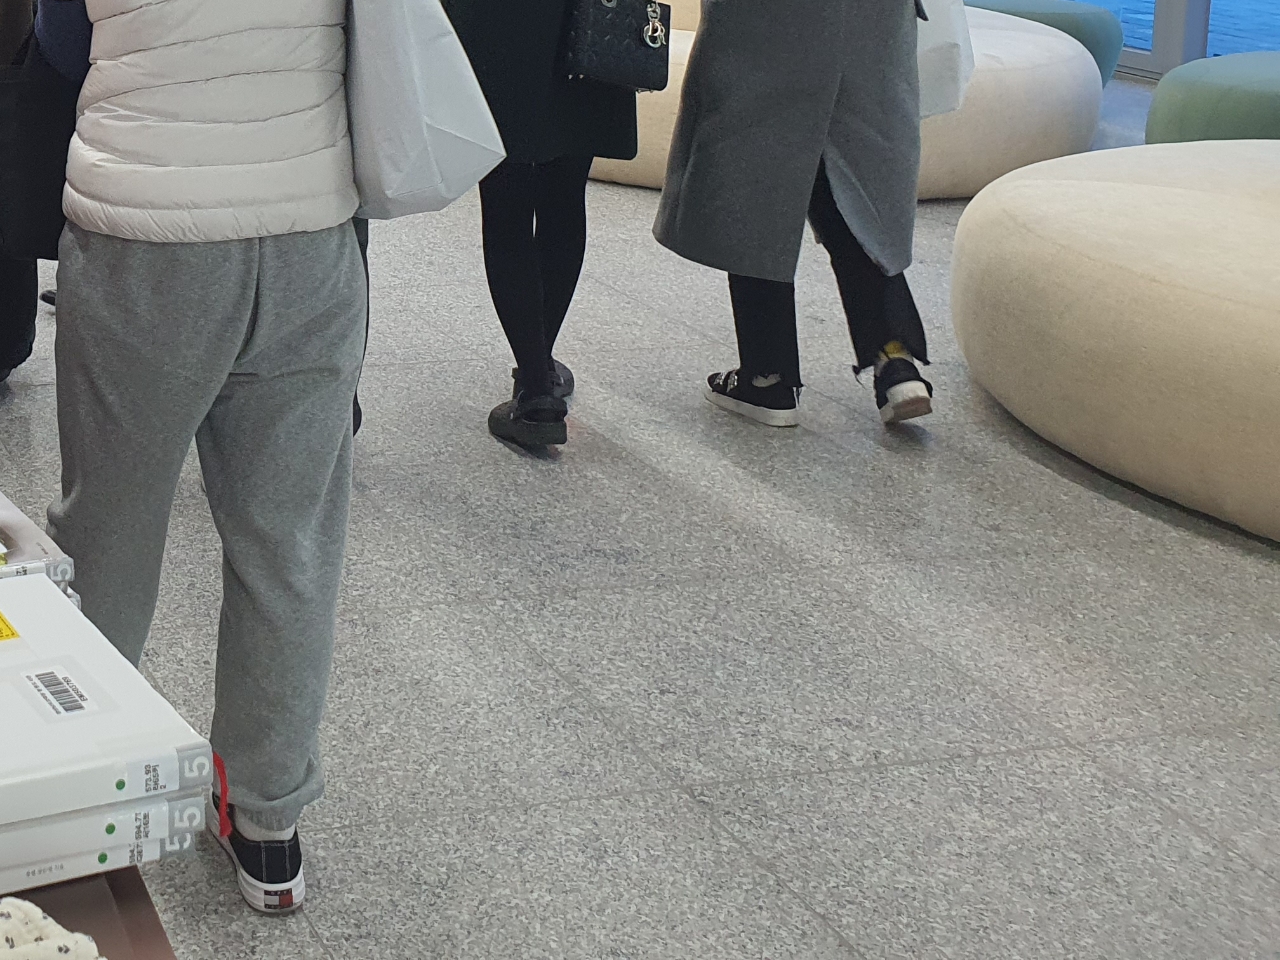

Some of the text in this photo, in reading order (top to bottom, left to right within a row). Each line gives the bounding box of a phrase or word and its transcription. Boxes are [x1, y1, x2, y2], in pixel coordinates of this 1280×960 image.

[144, 763, 152, 793] 573.93
[184, 755, 210, 778] 5
[174, 806, 201, 828] 5
